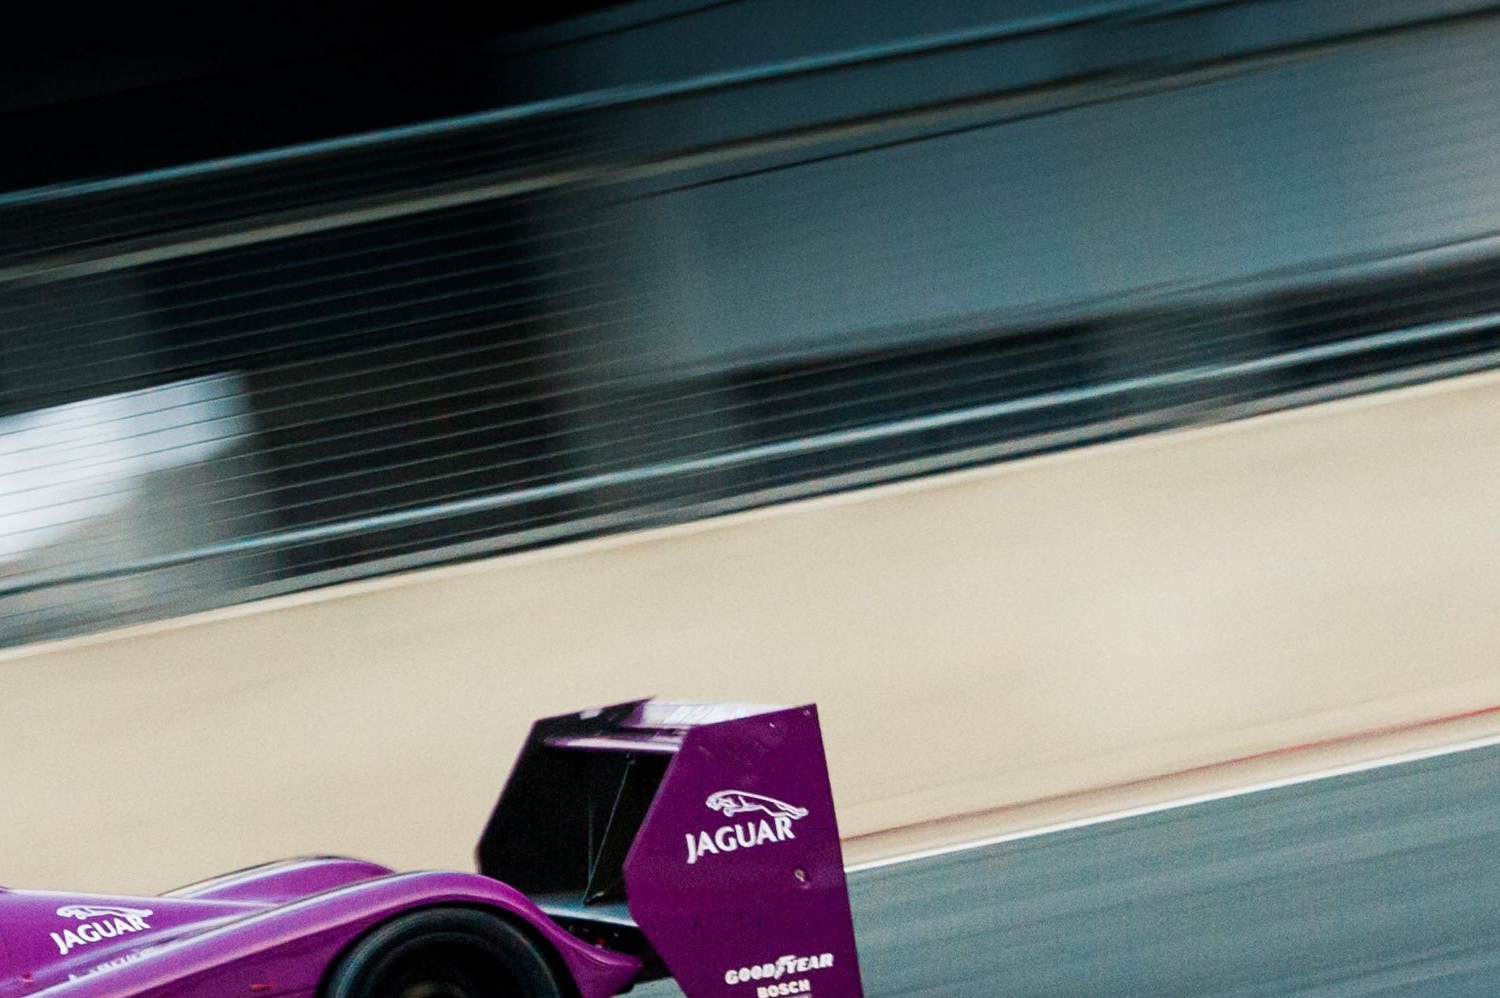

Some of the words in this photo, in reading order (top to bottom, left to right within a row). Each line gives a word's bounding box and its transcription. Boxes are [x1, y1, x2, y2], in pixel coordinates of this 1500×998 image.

[685, 816, 796, 864] JAGUAR
[49, 915, 152, 955] JAGUAR
[724, 952, 835, 985] GOODYEAR
[756, 978, 811, 998] BOSCH
